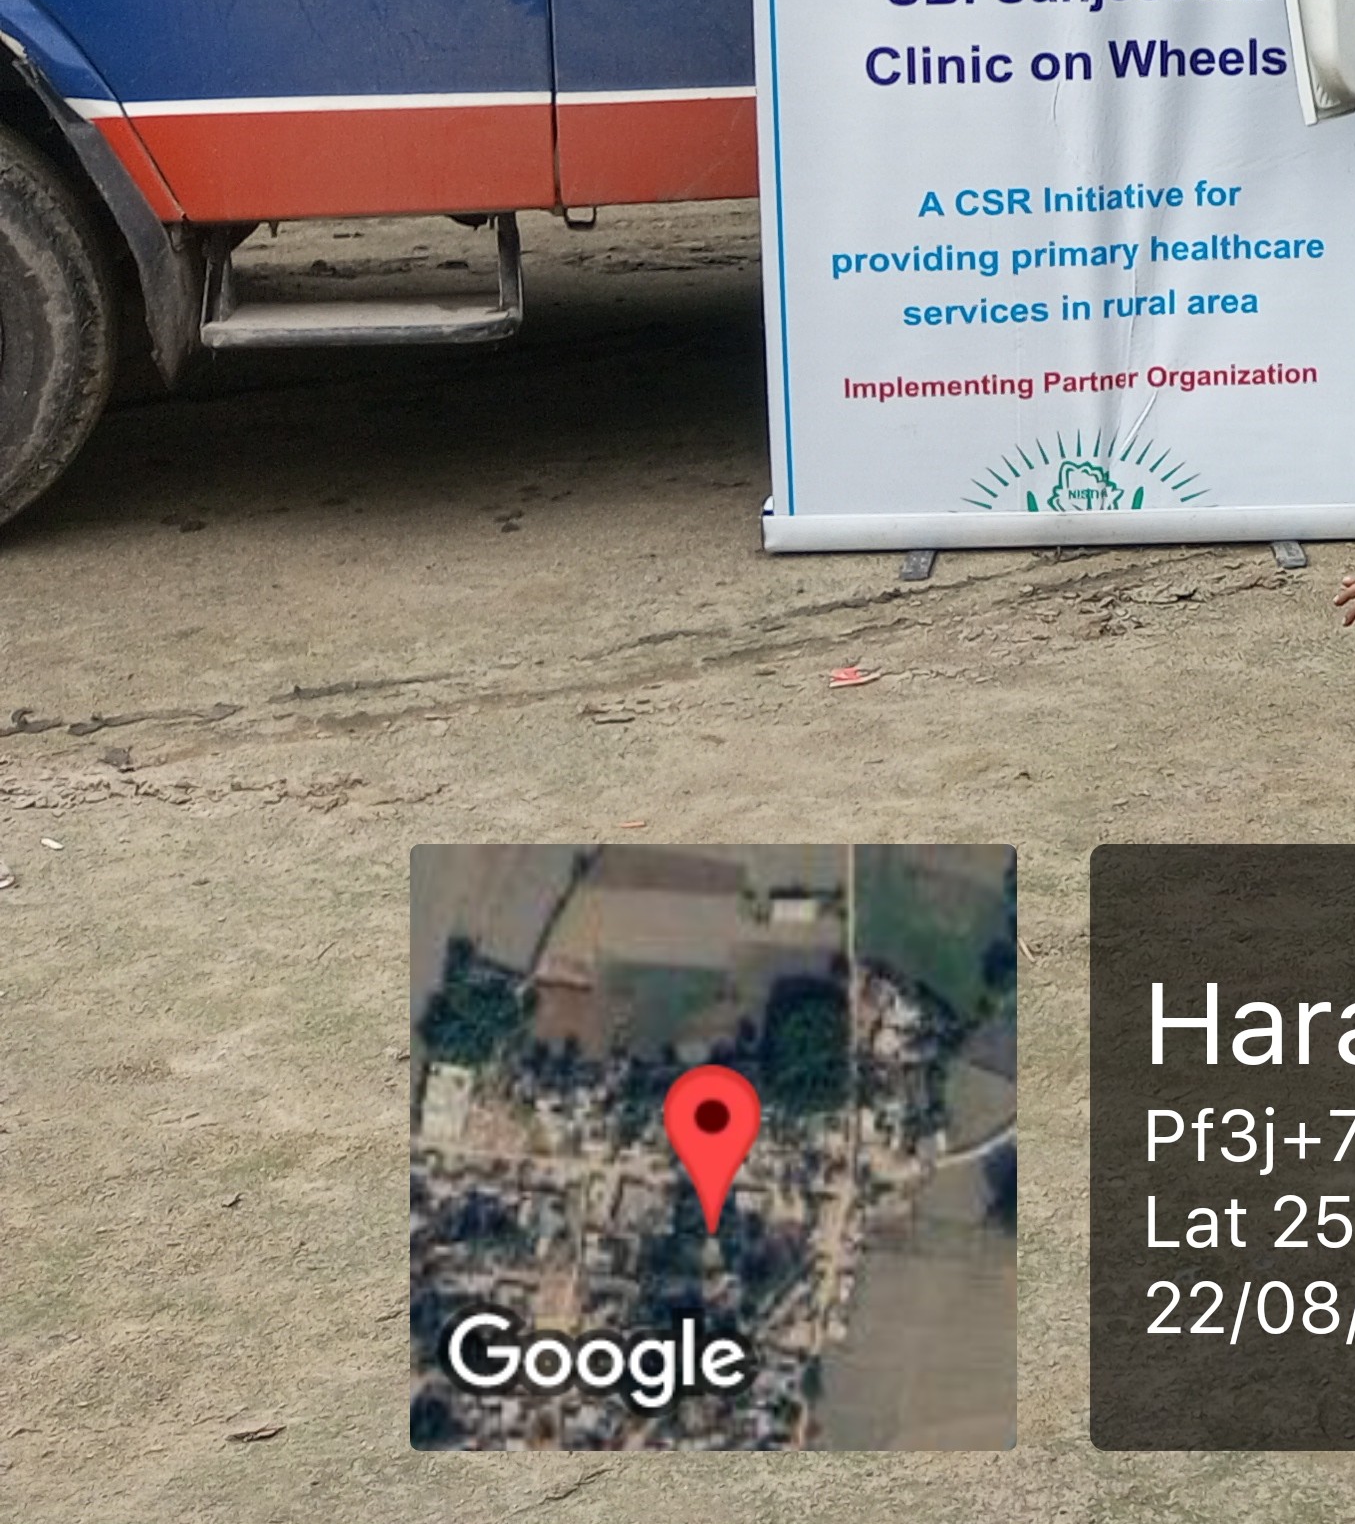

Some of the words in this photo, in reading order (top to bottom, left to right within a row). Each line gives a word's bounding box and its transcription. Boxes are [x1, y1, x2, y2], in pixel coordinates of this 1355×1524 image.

[865, 44, 1013, 86] Clinic
[1030, 51, 1092, 81] on
[1108, 38, 1288, 79] Wheels
[917, 192, 944, 217] A
[955, 188, 1033, 217] CSR
[1044, 184, 1183, 213] Initiative
[1194, 180, 1242, 207] for
[831, 244, 999, 279] providing
[1011, 240, 1139, 275] primary
[1150, 234, 1325, 262] healthcare
[903, 298, 1049, 326] services
[1062, 295, 1091, 321] in
[1103, 289, 1176, 319] rural
[1186, 289, 1259, 315] area
[844, 374, 1034, 403] Implementing
[1044, 371, 1138, 394] Partner
[1147, 362, 1318, 391] Organization
